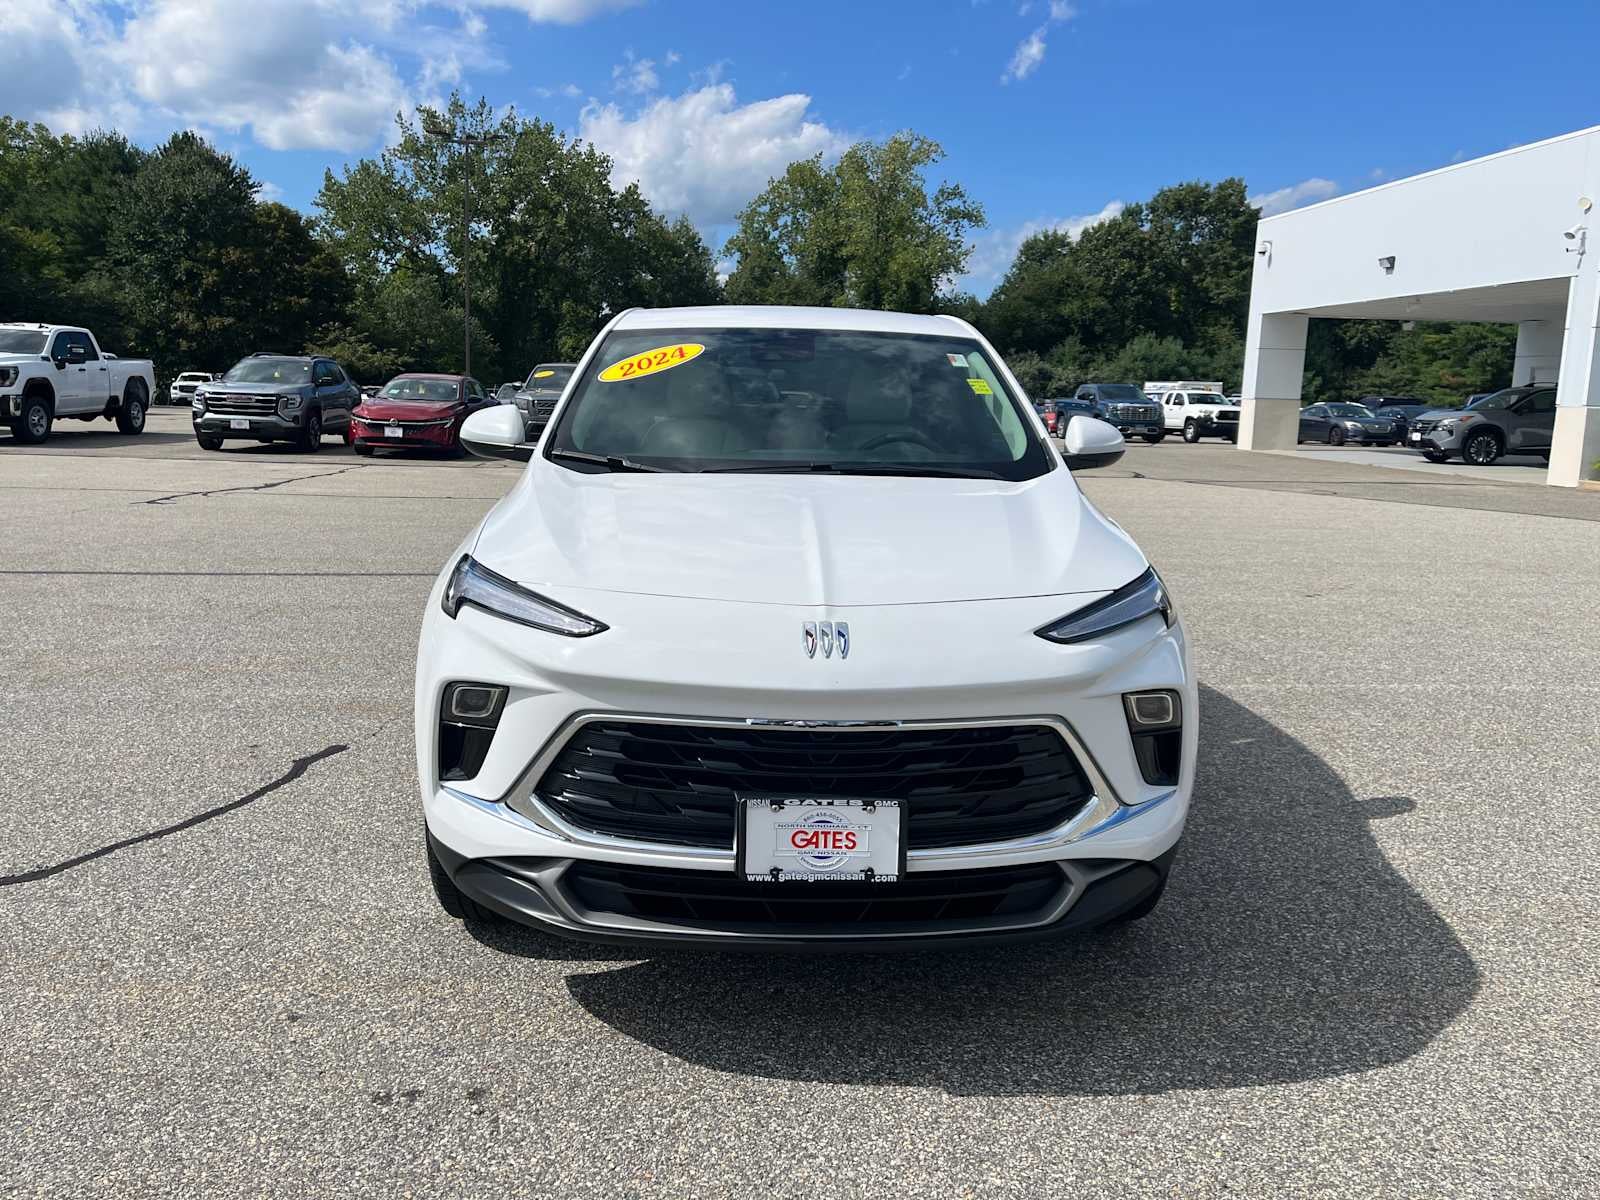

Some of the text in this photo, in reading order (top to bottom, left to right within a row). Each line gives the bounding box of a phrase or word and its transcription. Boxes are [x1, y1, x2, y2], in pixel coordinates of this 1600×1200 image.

[620, 347, 688, 377] 2024
[746, 799, 771, 808] NISSAN
[791, 830, 857, 850] GATES
